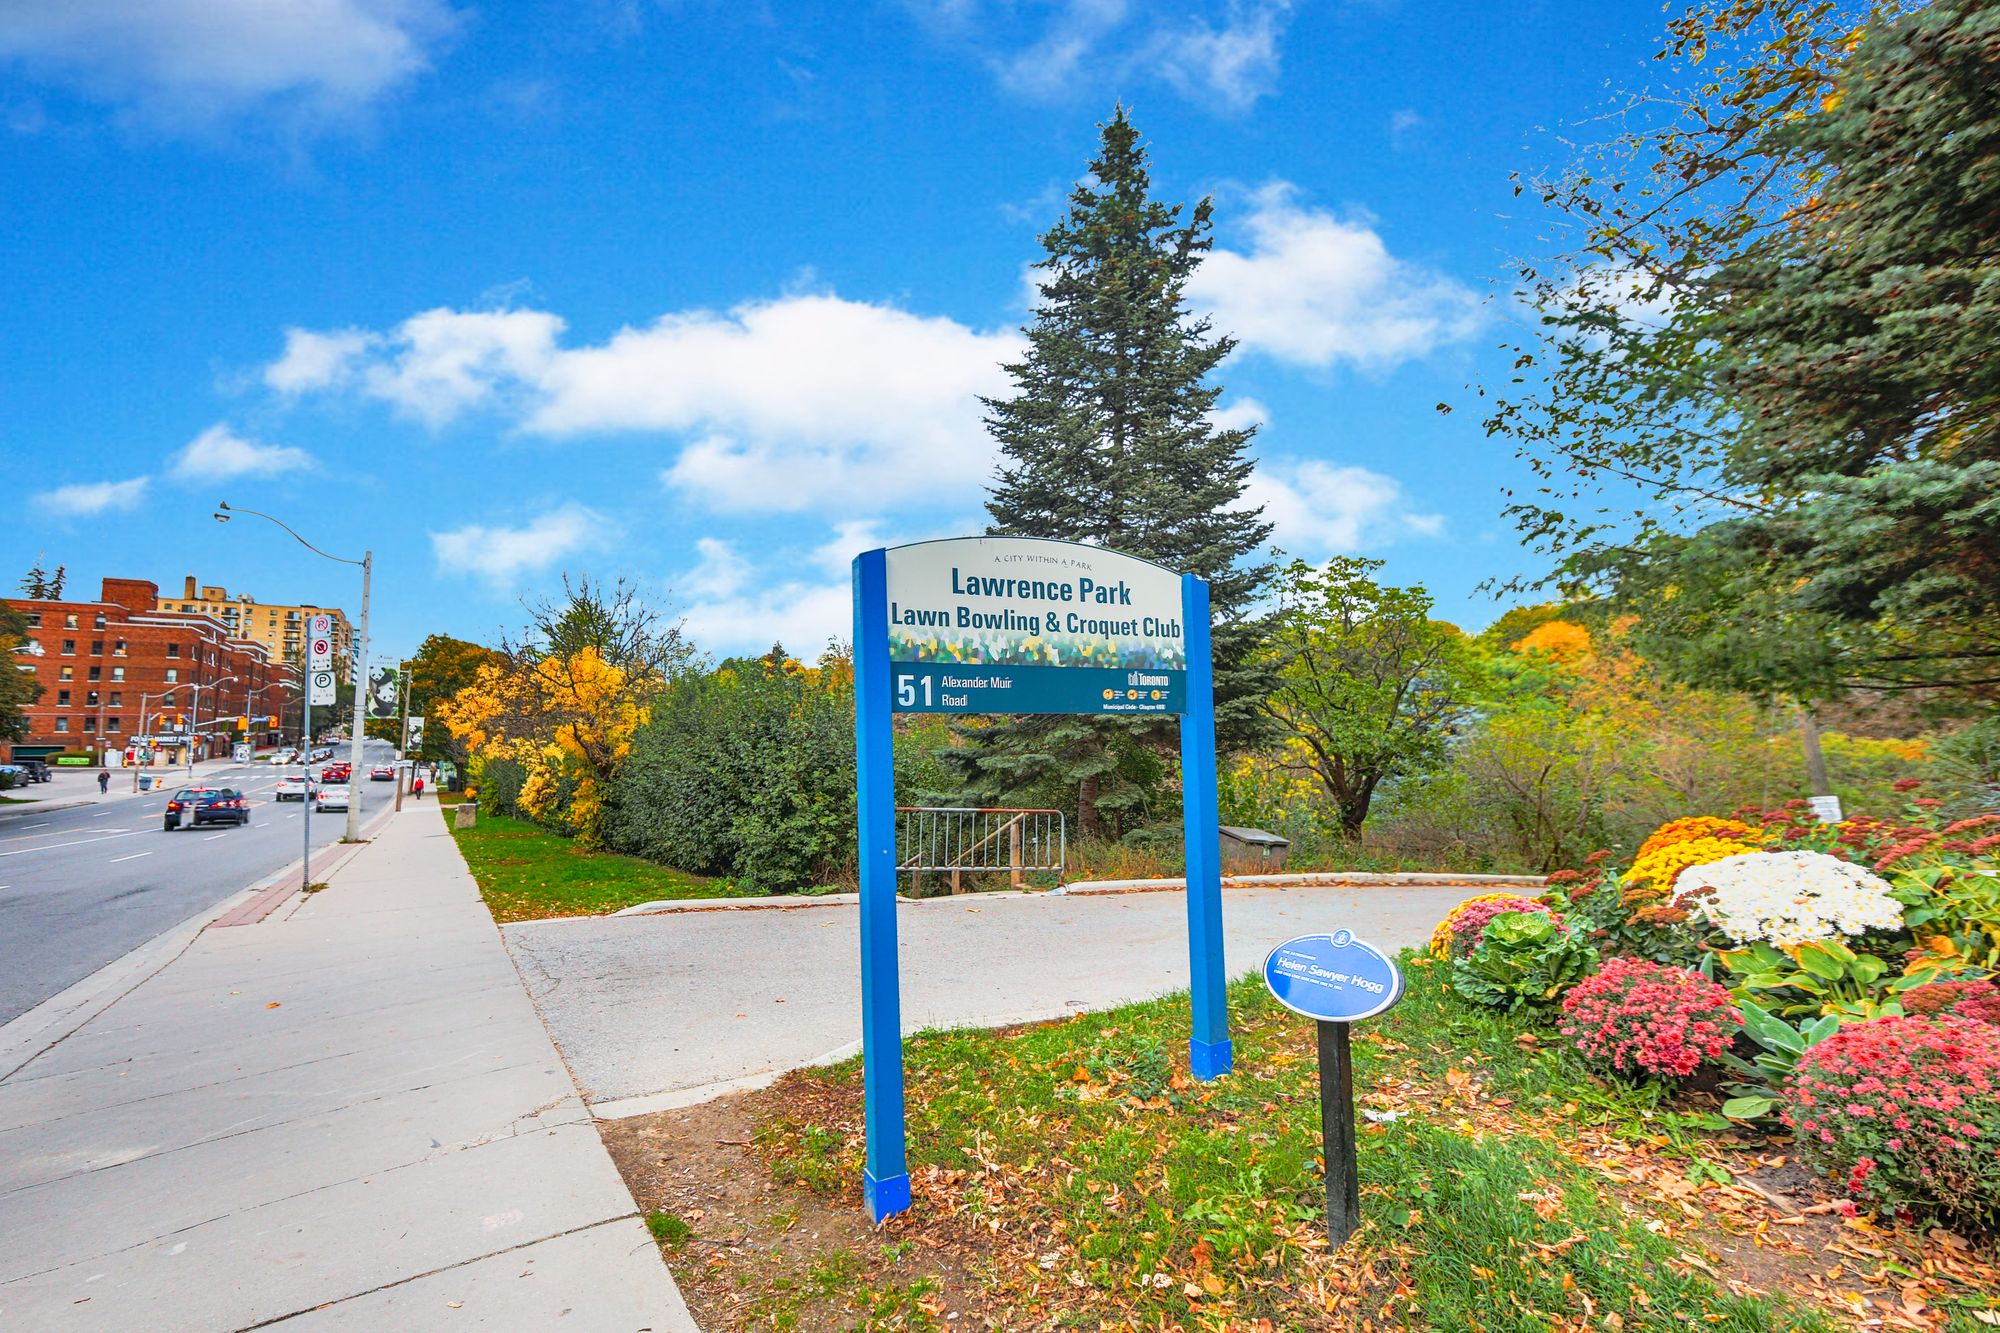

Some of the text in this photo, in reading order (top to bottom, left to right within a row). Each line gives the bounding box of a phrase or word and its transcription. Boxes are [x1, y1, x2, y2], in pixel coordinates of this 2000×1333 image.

[1027, 555, 1058, 564] WITHIN
[1071, 560, 1092, 571] PARK
[952, 567, 1132, 605] Lawrence Park
[891, 602, 1180, 639] Lawn Bowling & Croquet Club
[898, 674, 933, 706] 51
[941, 675, 1013, 688] Alexander Muir
[1138, 673, 1169, 686] TORONTO
[942, 694, 967, 706] Road
[1276, 956, 1307, 973] Helen
[1308, 964, 1350, 984] Sawyer
[1351, 975, 1384, 995] Hogg
